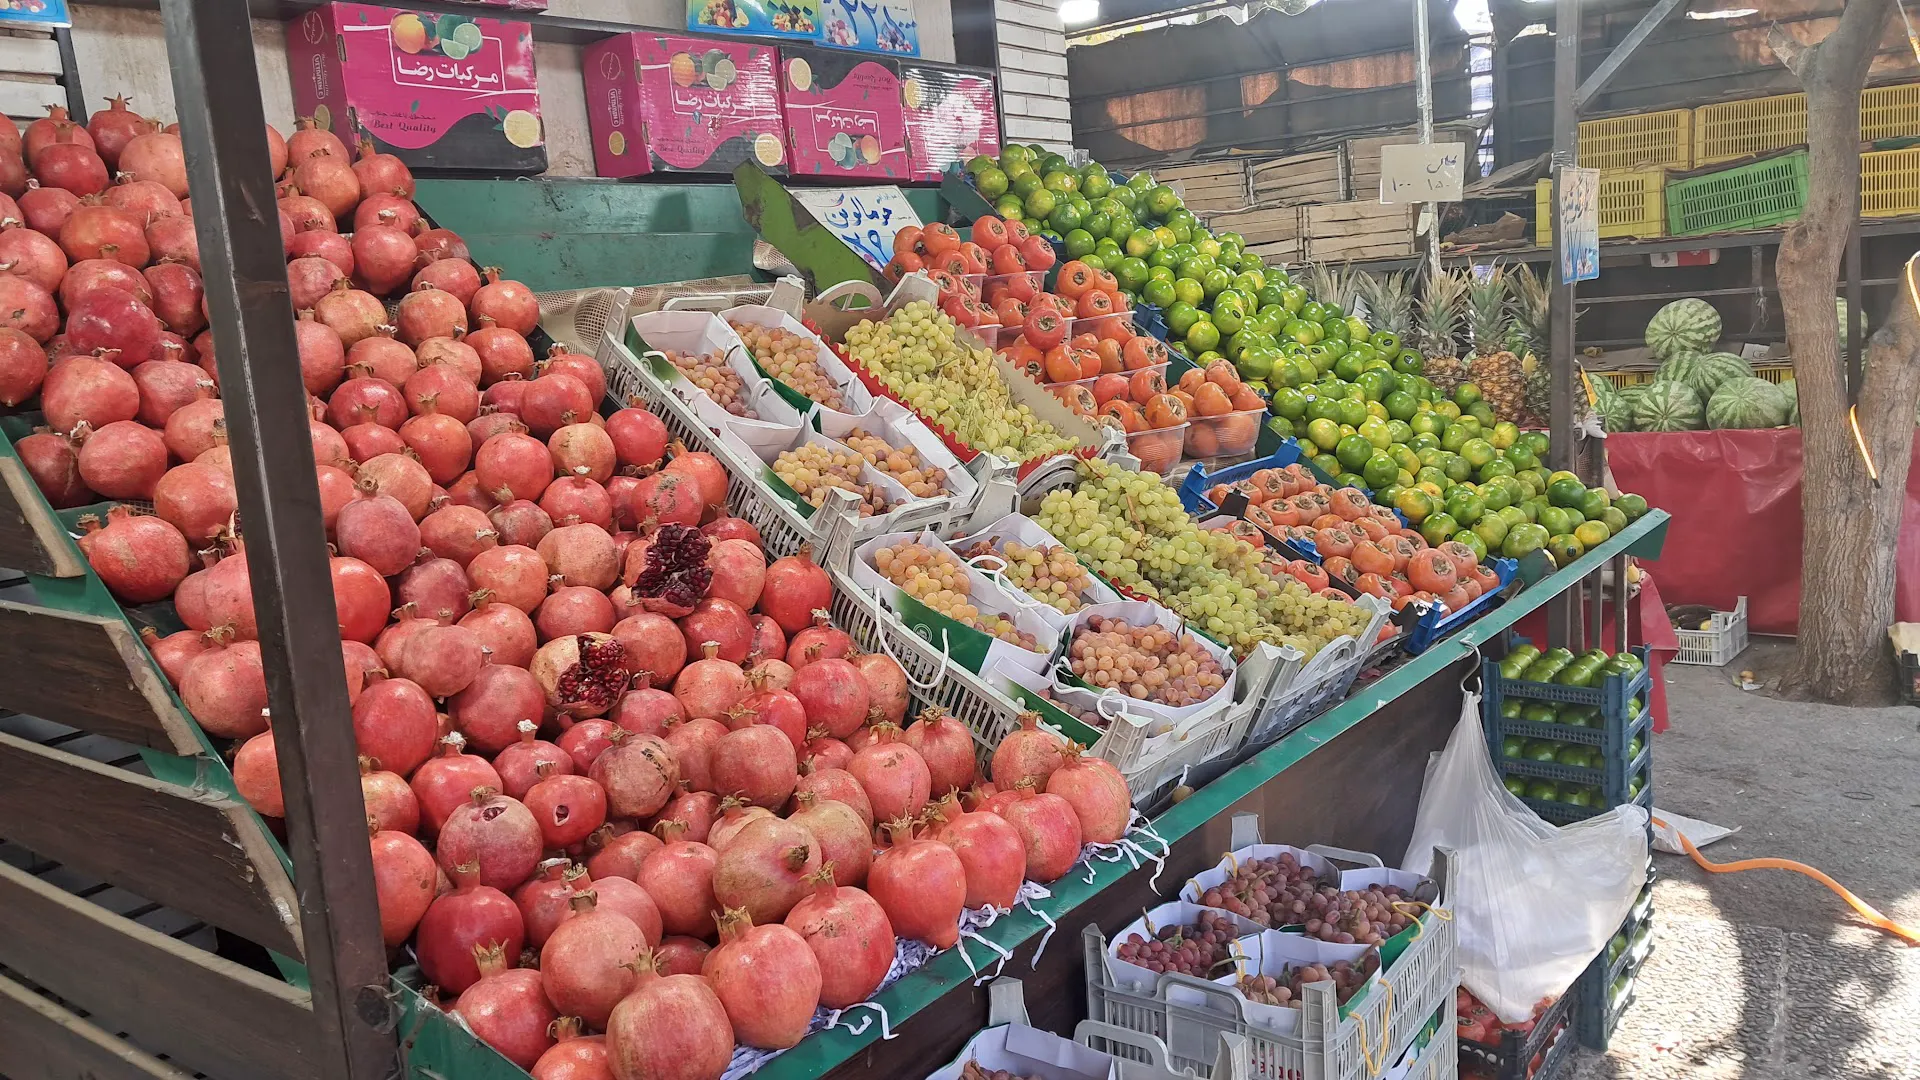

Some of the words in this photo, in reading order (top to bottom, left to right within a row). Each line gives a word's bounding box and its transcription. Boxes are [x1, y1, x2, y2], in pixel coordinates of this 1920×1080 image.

[396, 56, 435, 81] رضا
[435, 62, 499, 88] مرکبات
[674, 89, 702, 110] رضا
[703, 90, 754, 116] رکبات
[373, 119, 393, 129] Best
[398, 121, 437, 133] Quality
[815, 110, 854, 130] مرکبات
[854, 114, 877, 133] رضا
